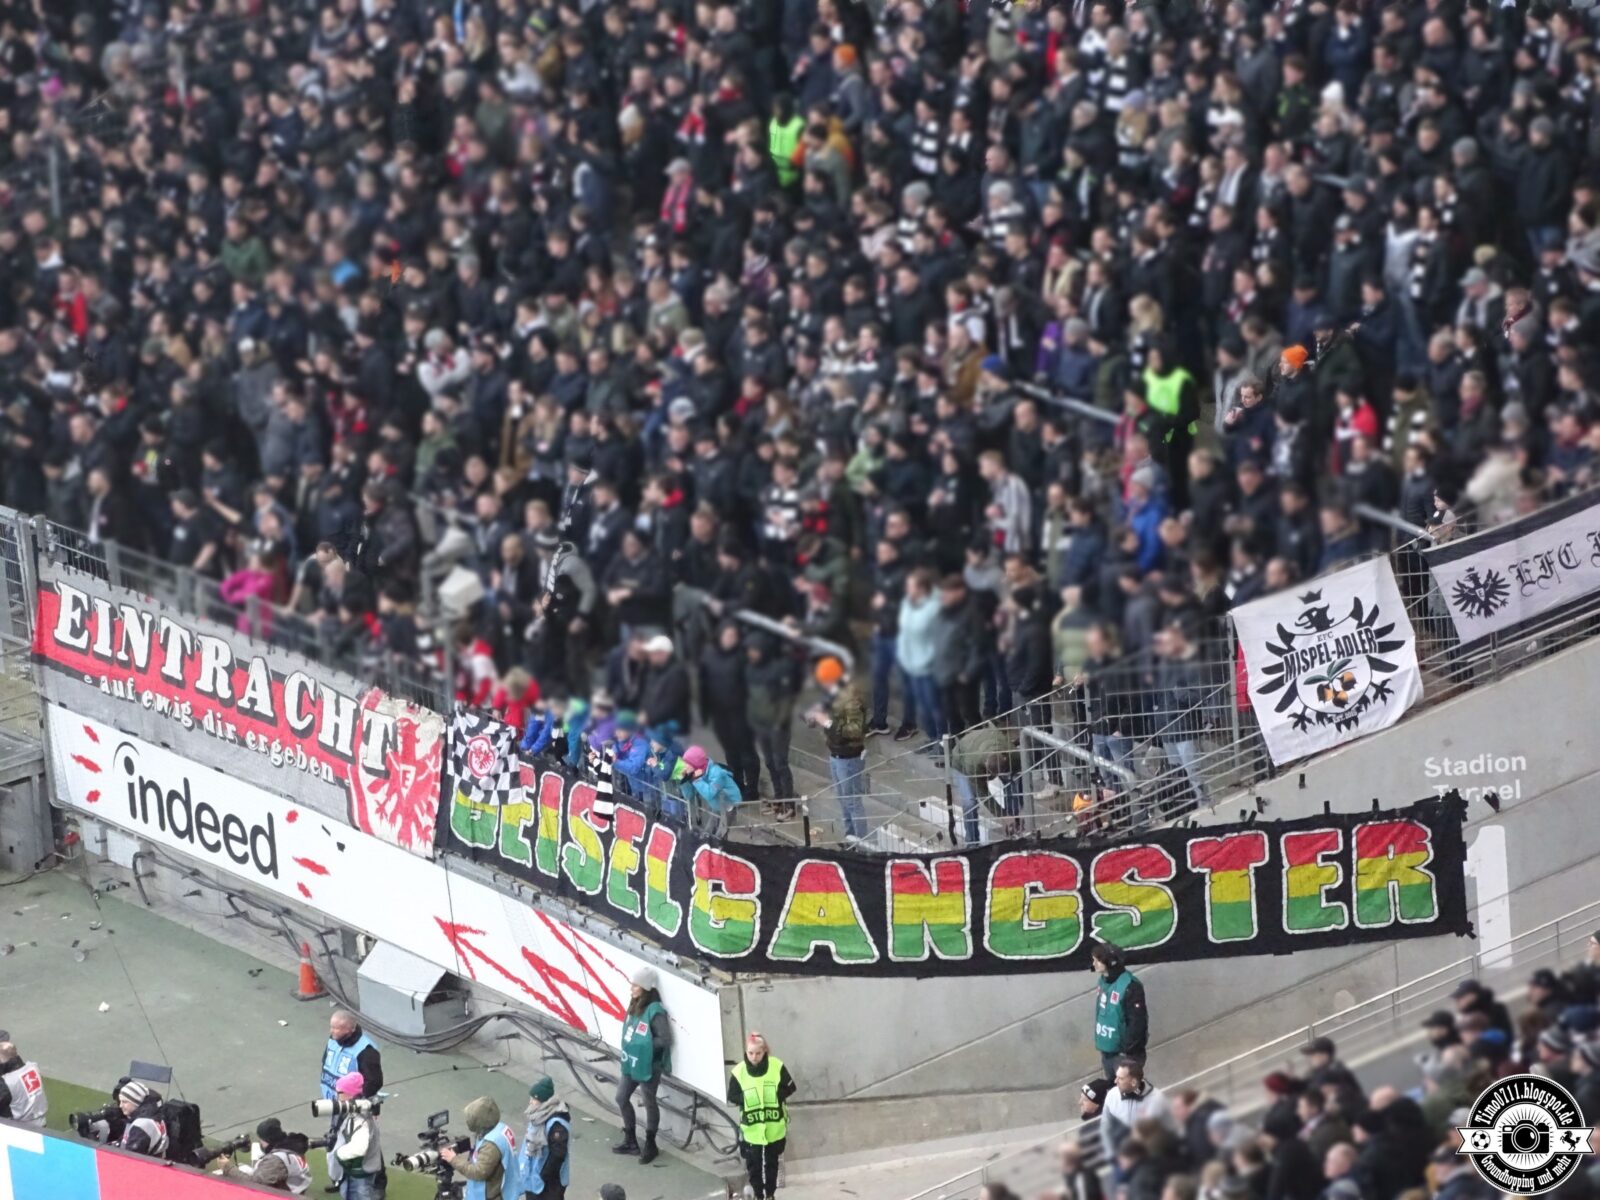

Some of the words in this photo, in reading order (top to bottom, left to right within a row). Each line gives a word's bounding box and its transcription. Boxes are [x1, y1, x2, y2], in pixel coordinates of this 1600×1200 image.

[1508, 541, 1581, 597] EFC
[53, 581, 397, 772] EINTRACHT
[1283, 627, 1378, 682] MISPEL-ADLER
[100, 675, 135, 702] auf
[142, 690, 193, 728] ewig
[202, 709, 237, 741] dir
[246, 731, 334, 783] ergeben
[1424, 754, 1526, 777] Stadion
[113, 741, 279, 880] indeed
